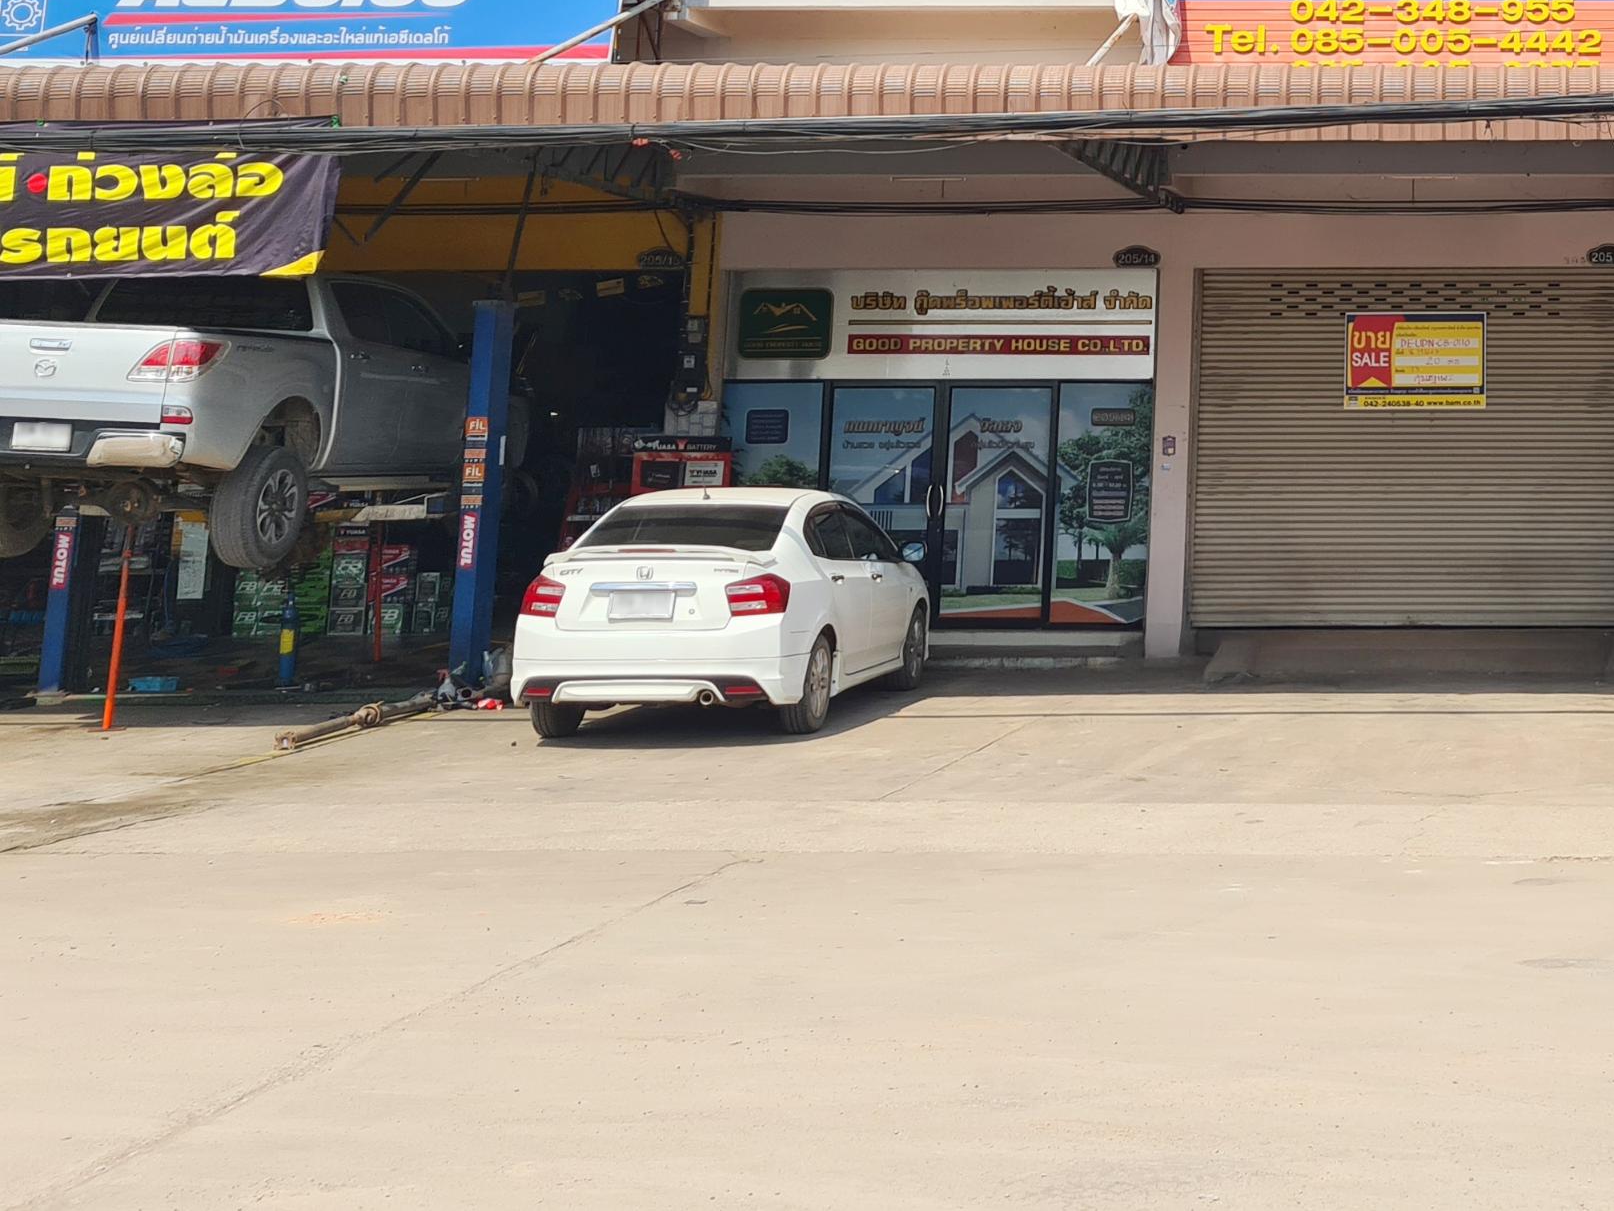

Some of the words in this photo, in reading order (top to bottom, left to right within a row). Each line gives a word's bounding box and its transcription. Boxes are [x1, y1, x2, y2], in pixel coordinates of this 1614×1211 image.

[1205, 24, 1279, 54] Tel.
[1290, 27, 1602, 55] 085-005-4442
[1118, 253, 1155, 264] 205/14
[851, 291, 906, 310] บริษัท
[1104, 289, 1153, 310] จำกัด
[853, 339, 901, 351] GOOD
[909, 339, 1008, 351] PROPERTY
[1011, 339, 1071, 351] HOUSE
[1352, 331, 1390, 349] ขาย
[1352, 352, 1390, 367] SALE
[460, 515, 476, 567] MOTUL
[52, 534, 70, 585] MOTUL
